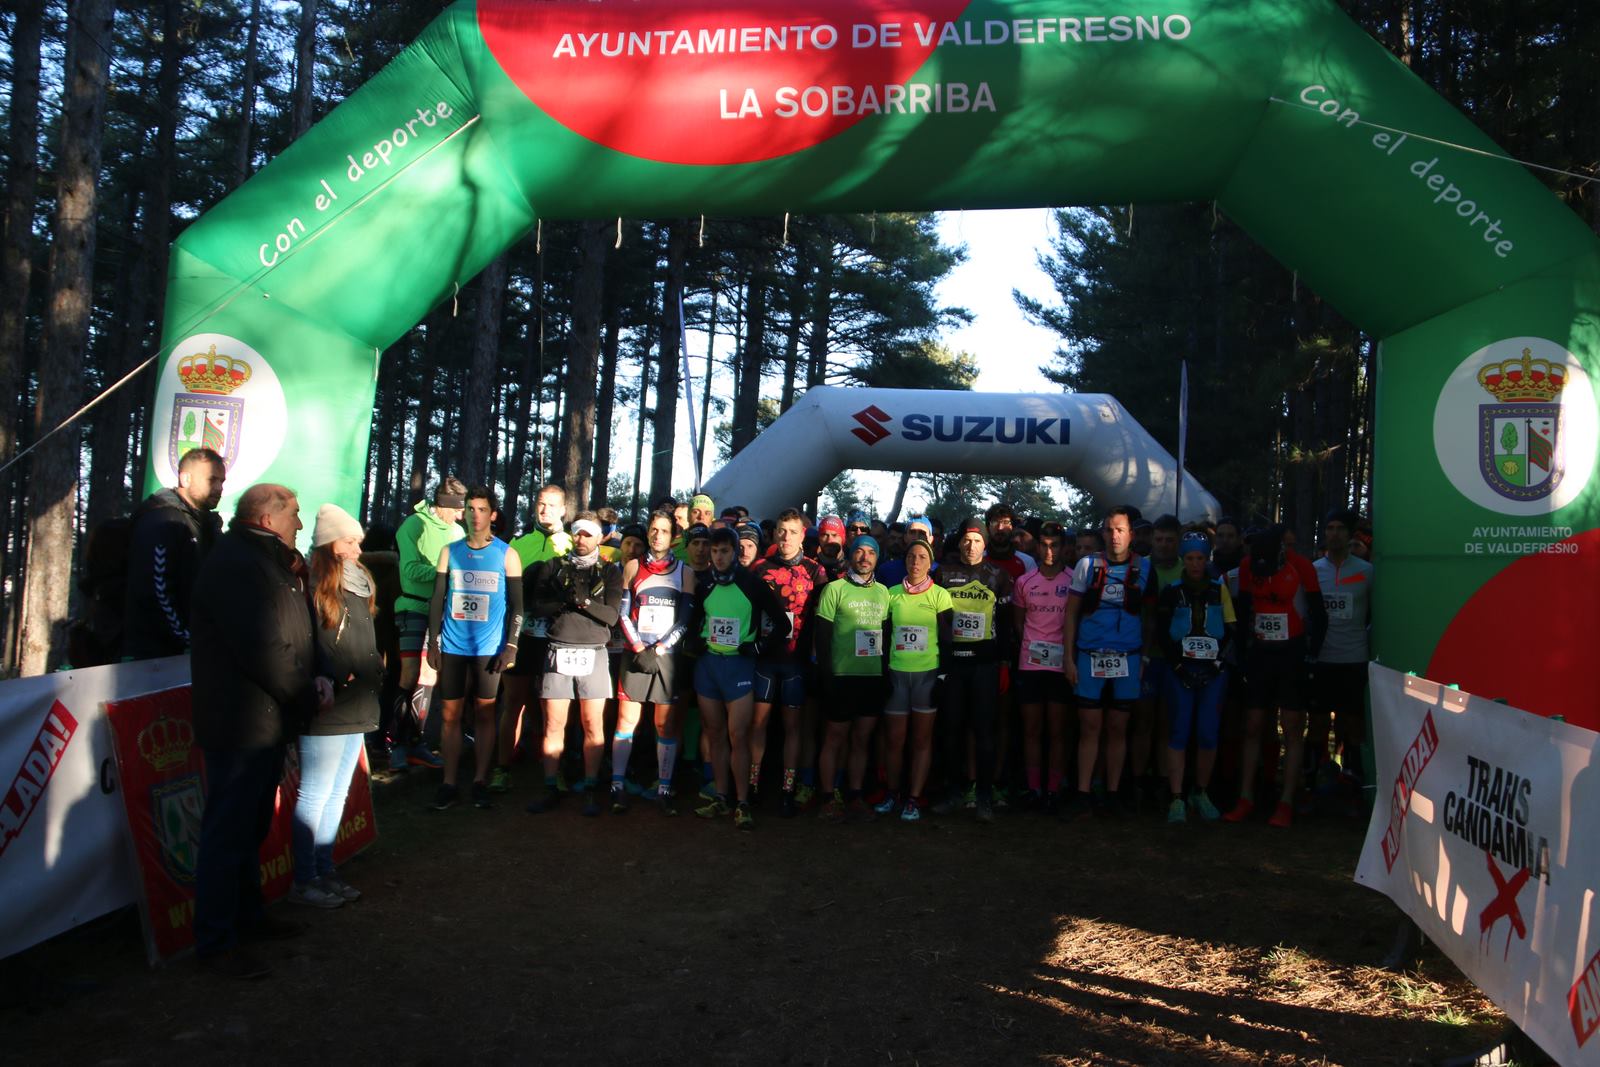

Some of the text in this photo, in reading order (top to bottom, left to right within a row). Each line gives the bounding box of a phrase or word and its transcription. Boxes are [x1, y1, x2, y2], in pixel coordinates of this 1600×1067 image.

[552, 14, 1192, 58] AYUNTAMIENTO DE VALDEFRESNO
[719, 82, 997, 119] LA SOBARRIBA
[1300, 84, 1513, 258] Con el deporte
[259, 101, 453, 267] Con el deporte
[901, 413, 1071, 446] SUZUKI
[1472, 526, 1573, 538] AYUNTAMIENTO
[1464, 543, 1579, 554] DE VALDEFRESNO
[462, 601, 478, 612] 20
[712, 625, 733, 635] 142
[957, 619, 979, 630] 363
[1259, 621, 1281, 631] 485
[869, 637, 876, 647] 9
[903, 633, 917, 642] 10
[1188, 641, 1212, 651] 259
[1041, 649, 1049, 658] 3
[563, 655, 588, 666] 413
[1098, 658, 1121, 669] 463
[1467, 755, 1531, 827] TRANS
[1444, 791, 1551, 886] CANDAMIA
